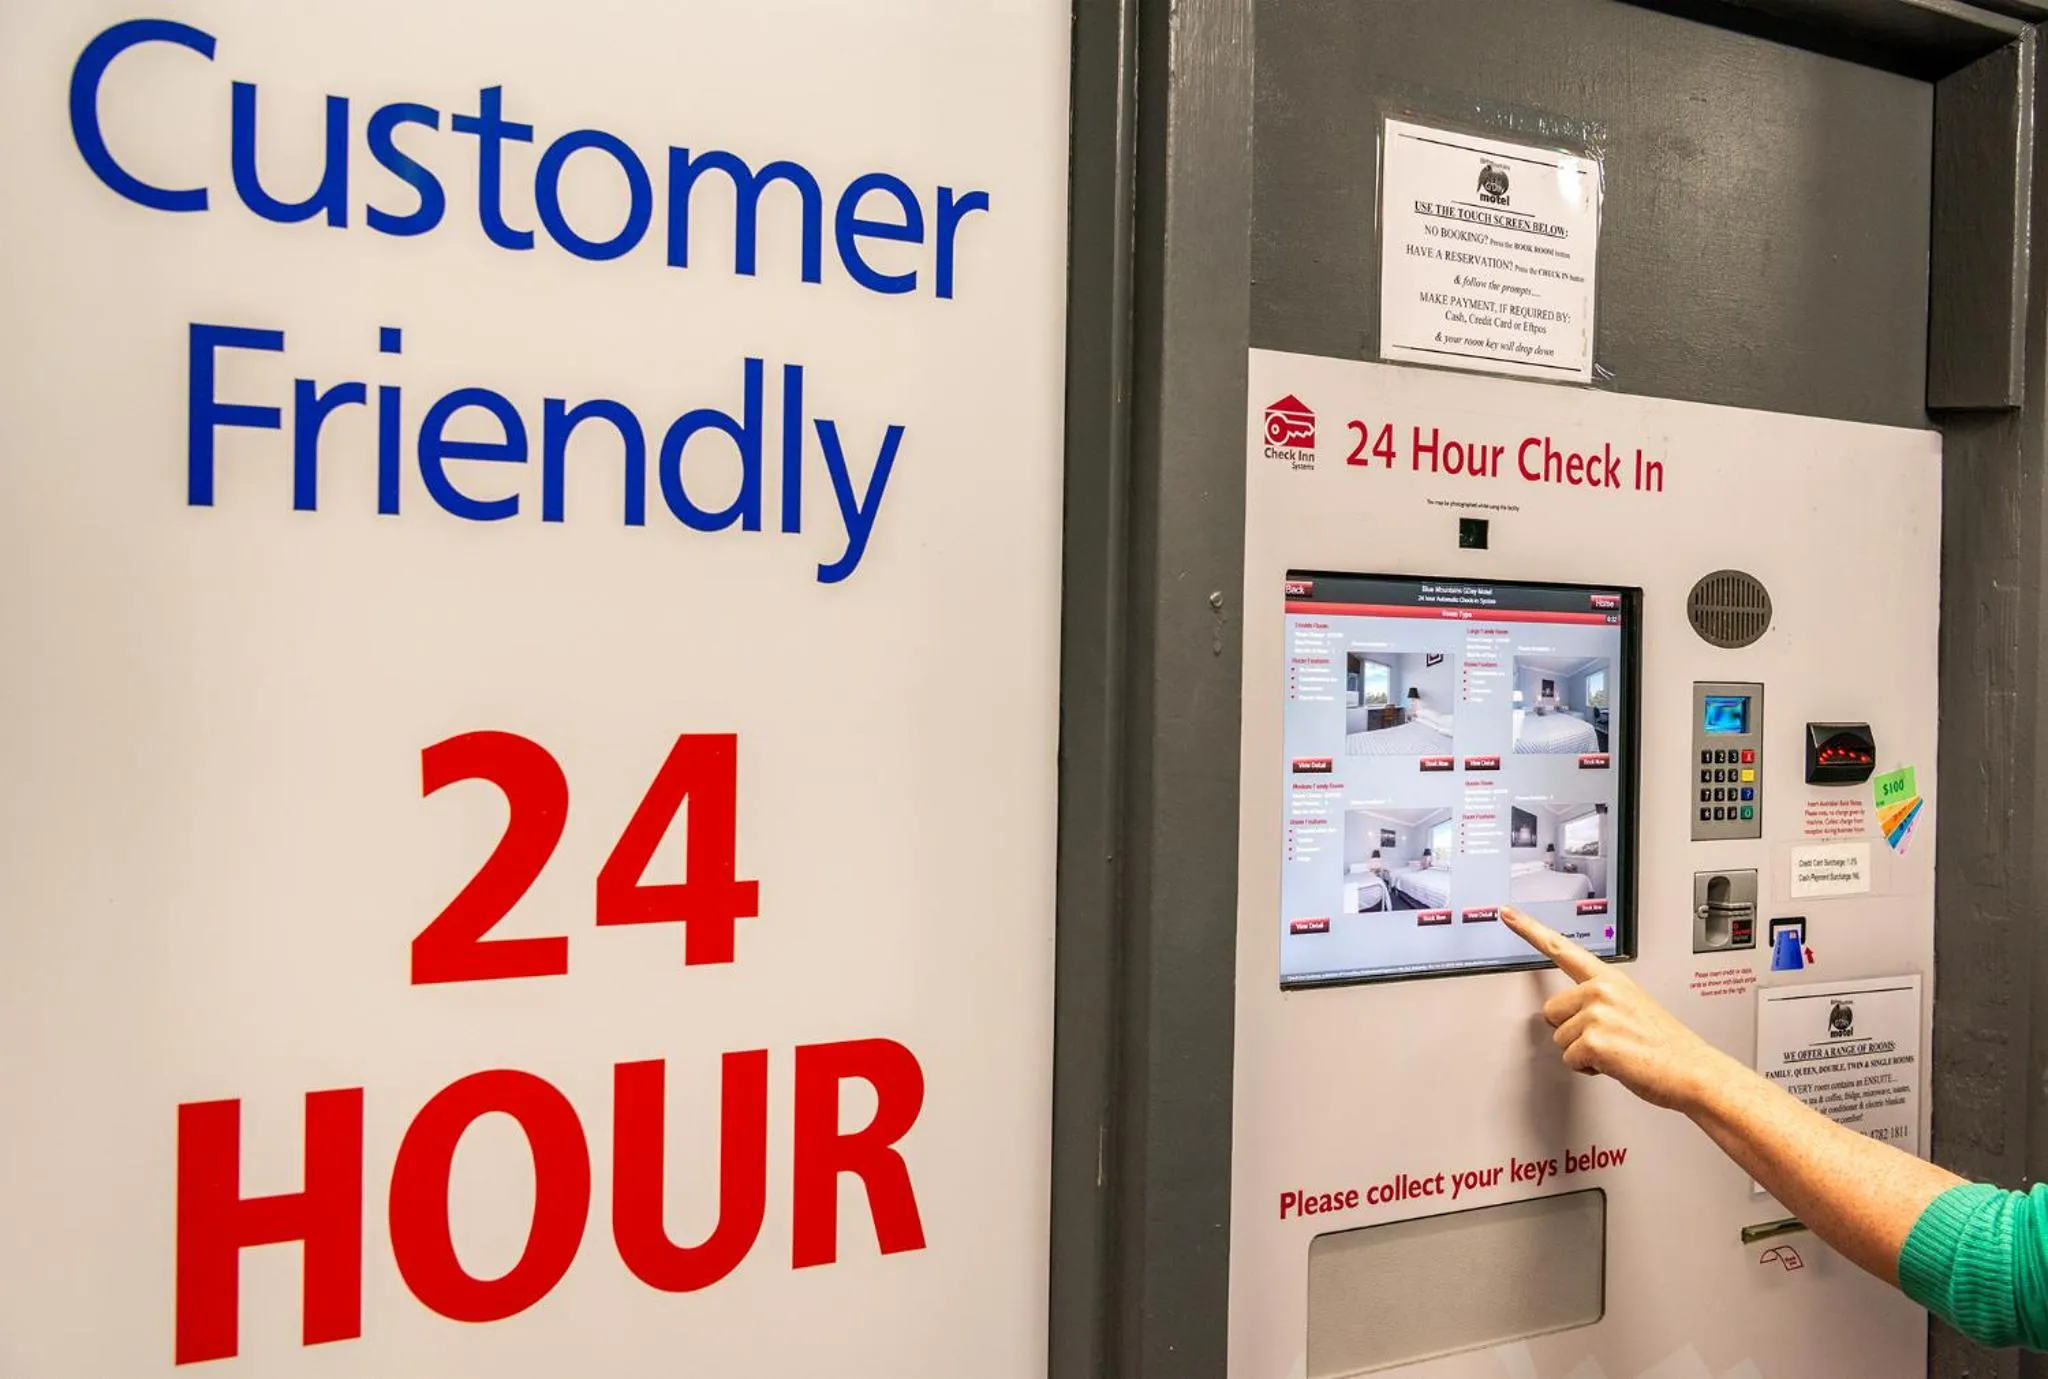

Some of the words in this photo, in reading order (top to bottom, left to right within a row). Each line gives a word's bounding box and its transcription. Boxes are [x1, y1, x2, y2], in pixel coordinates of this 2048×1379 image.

[68, 18, 990, 300] Customer
[1480, 193, 1510, 206] motel
[1415, 200, 1433, 213] USE
[1436, 204, 1455, 217] THE
[1457, 208, 1492, 224] TOUCH
[1493, 214, 1530, 230] SCREEN
[1533, 222, 1568, 237] BELOW:
[1425, 224, 1439, 237] NO
[1441, 227, 1489, 244] BOOKING?
[1406, 244, 1433, 258] HAVE
[1436, 250, 1442, 260] A
[1445, 250, 1513, 271] RESERVATION?
[1454, 274, 1461, 285] &
[1462, 275, 1487, 288] follow
[1488, 280, 1500, 291] the
[1420, 291, 1448, 305] MAKE
[1500, 303, 1508, 314] IF
[1510, 305, 1554, 321] REQUIRED
[1556, 311, 1571, 324] BY:
[1468, 313, 1492, 326] Credit
[1494, 317, 1512, 329] Card
[1513, 322, 1521, 330] or
[1523, 321, 1546, 335] Eftpos
[1434, 331, 1442, 342] &
[1443, 335, 1463, 344] your
[1464, 338, 1484, 347] room
[1485, 338, 1499, 350] key
[1500, 341, 1515, 351] will
[1515, 342, 1533, 356] drop
[1534, 345, 1554, 356] down
[187, 322, 905, 584] Friendly
[1264, 447, 1296, 461] Check
[1298, 450, 1315, 462] Inn
[1346, 419, 1397, 469] 24
[1412, 426, 1504, 478] Hour
[1518, 437, 1621, 489] Check
[1635, 449, 1664, 493] In
[1286, 584, 1305, 595] Back
[1882, 778, 1904, 796] $100
[410, 729, 760, 986] 24
[1784, 1051, 1797, 1060] WE
[1798, 1048, 1822, 1060] OFFER
[1824, 1048, 1829, 1058] A
[1831, 1045, 1855, 1057] RANGE
[1857, 1042, 1866, 1053] OF
[1847, 1061, 1863, 1071] TWIN
[1864, 1060, 1869, 1069] &
[1870, 1057, 1891, 1068] SINGLE
[1893, 1055, 1914, 1065] ROOMS
[1788, 1083, 1812, 1095] EVERY
[1819, 1095, 1824, 1104] &
[1890, 1125, 1908, 1139] 1811
[1280, 1190, 1359, 1220] Please
[1367, 1172, 1445, 1205] collect
[1451, 1167, 1504, 1200] your
[1510, 1157, 1558, 1186] keys
[1565, 1145, 1627, 1174] below
[174, 1037, 927, 1366] HOUR
